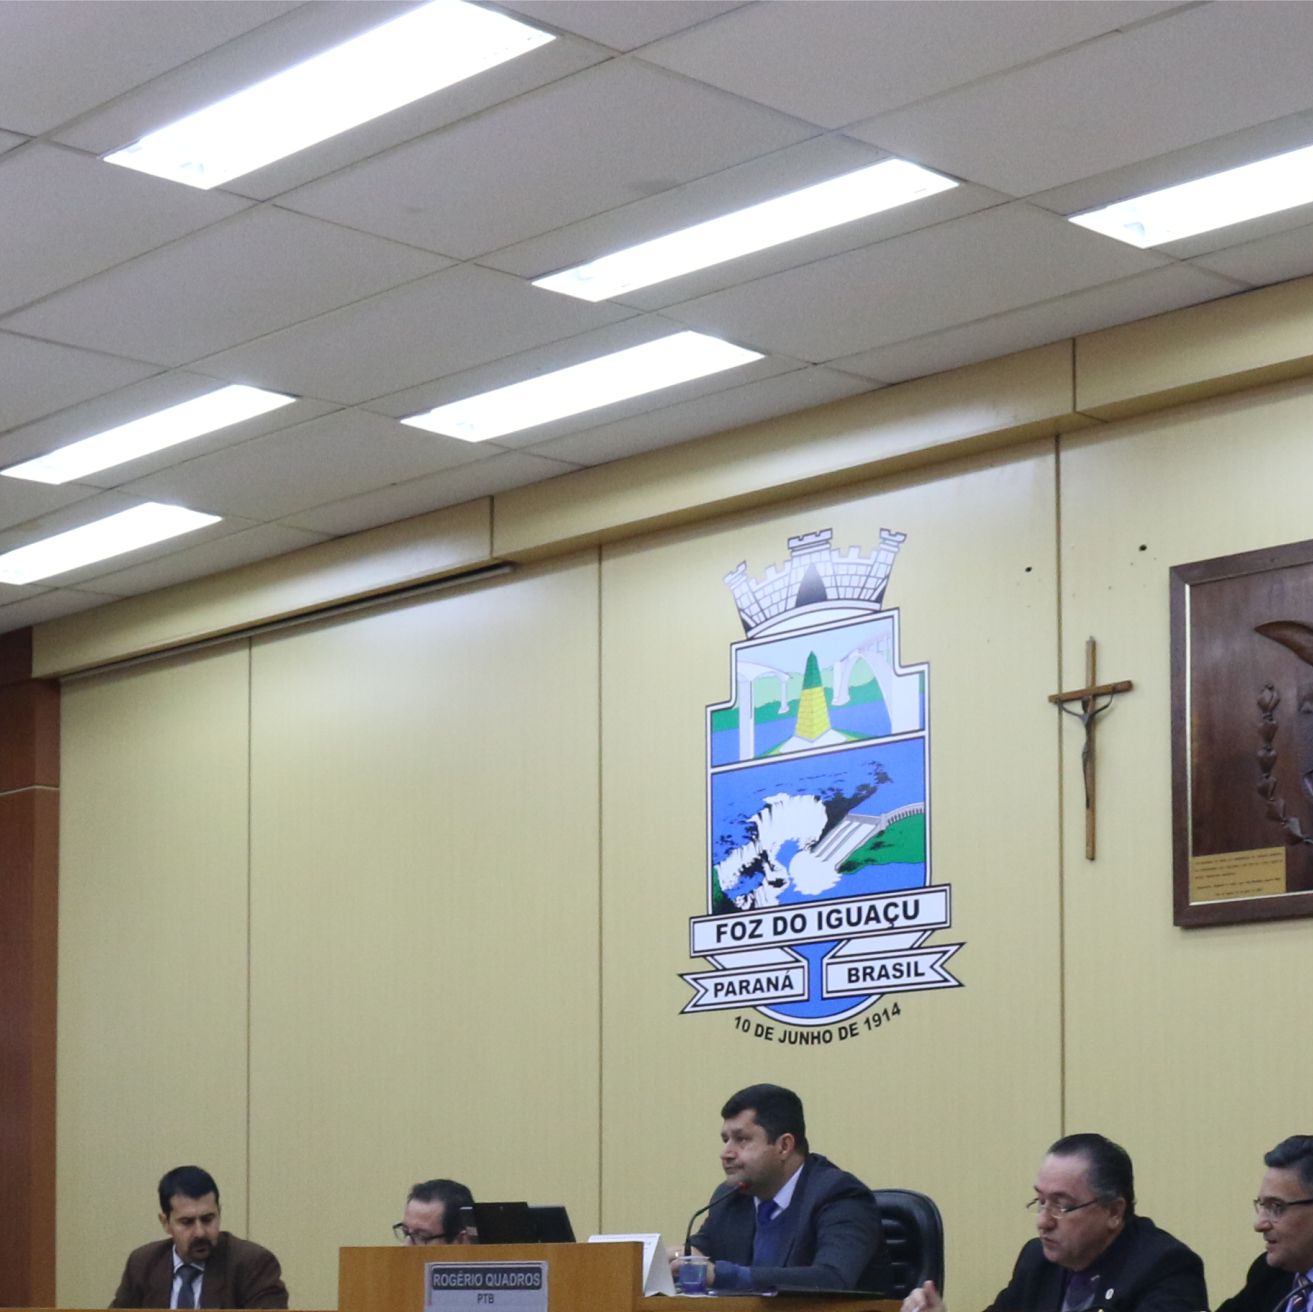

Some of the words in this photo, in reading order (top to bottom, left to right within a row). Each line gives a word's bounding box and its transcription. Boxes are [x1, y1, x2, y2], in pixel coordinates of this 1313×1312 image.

[716, 918, 764, 943] FOZ
[772, 913, 807, 937] DO
[817, 900, 920, 928] IGUAÇU
[714, 970, 794, 998] PARANÁ
[847, 960, 926, 984] BRASIL
[734, 1015, 750, 1033] 10
[754, 1024, 774, 1041] DE
[778, 1028, 833, 1045] JUNHO
[838, 1024, 860, 1042] DE
[864, 1002, 902, 1032] 1914
[434, 1270, 482, 1286] ROGÉRIO
[485, 1273, 540, 1286] QUADROS
[477, 1293, 494, 1304] PTB
